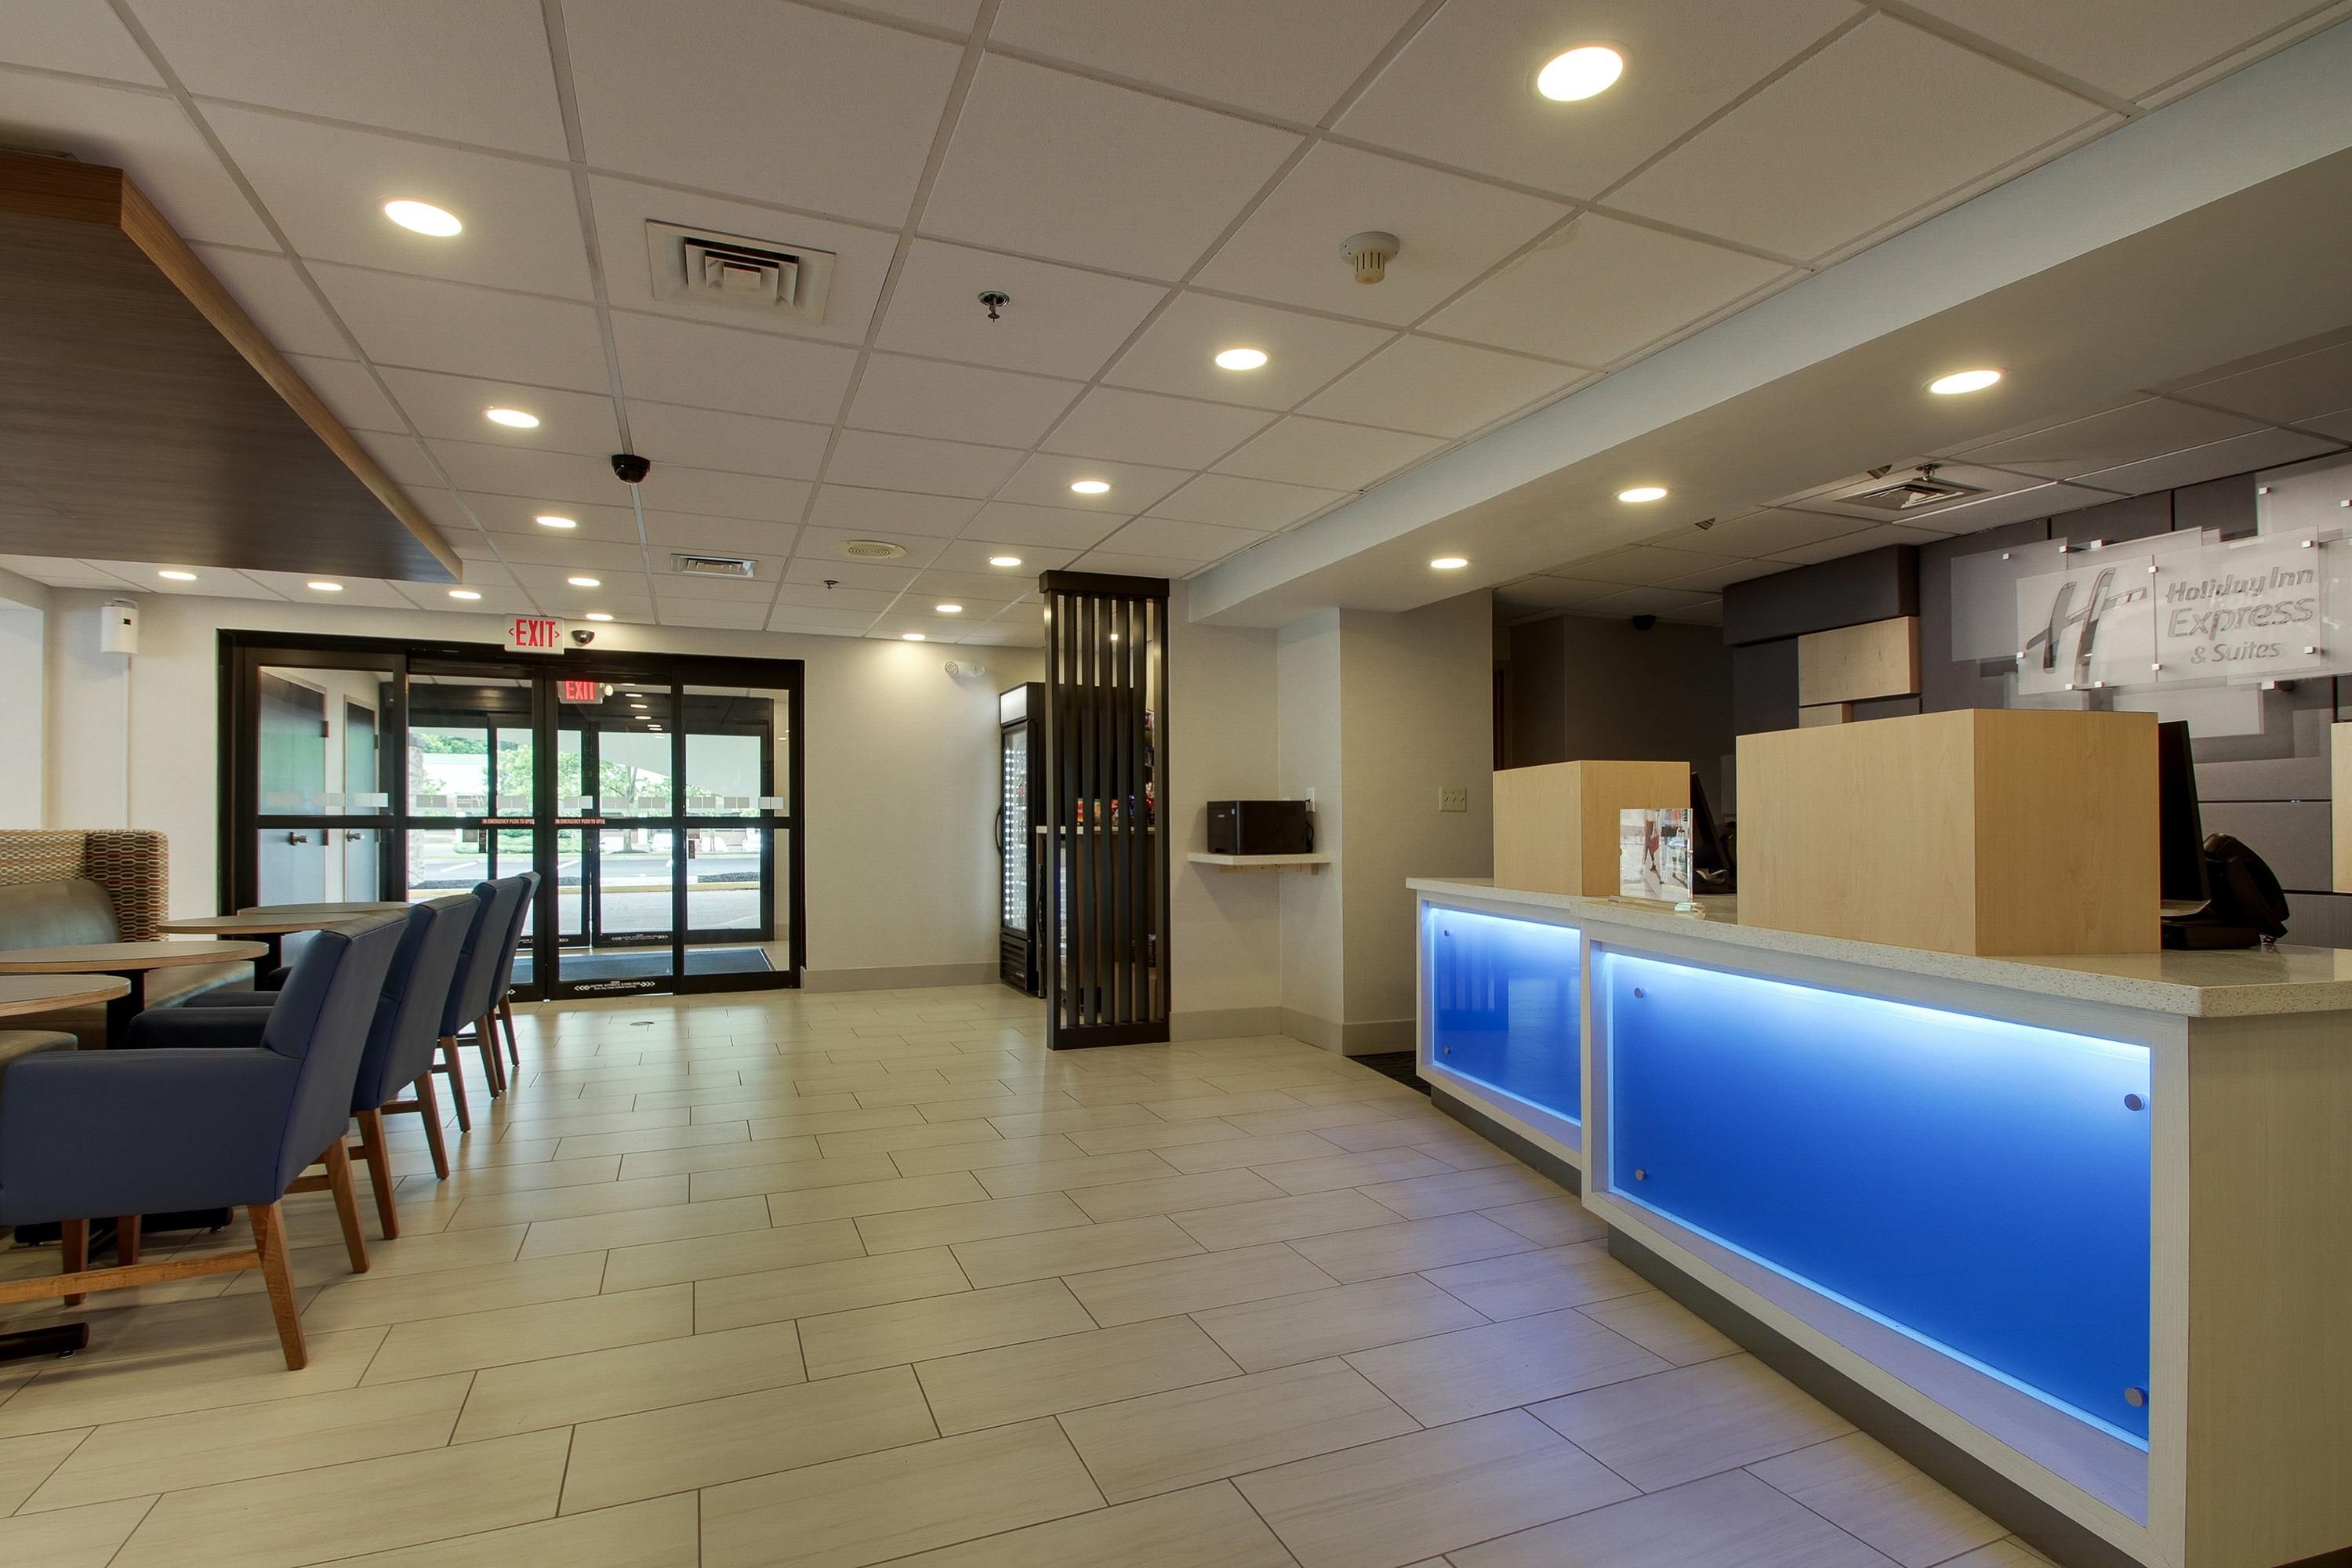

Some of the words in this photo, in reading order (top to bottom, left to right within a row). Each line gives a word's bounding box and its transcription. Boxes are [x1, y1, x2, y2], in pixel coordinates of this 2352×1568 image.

[2165, 574, 2266, 603] Holiday
[2270, 566, 2313, 588] Inn
[516, 619, 556, 648] EXIT
[2167, 597, 2314, 641] Express
[2190, 645, 2206, 664] &
[2211, 641, 2282, 662] Suites
